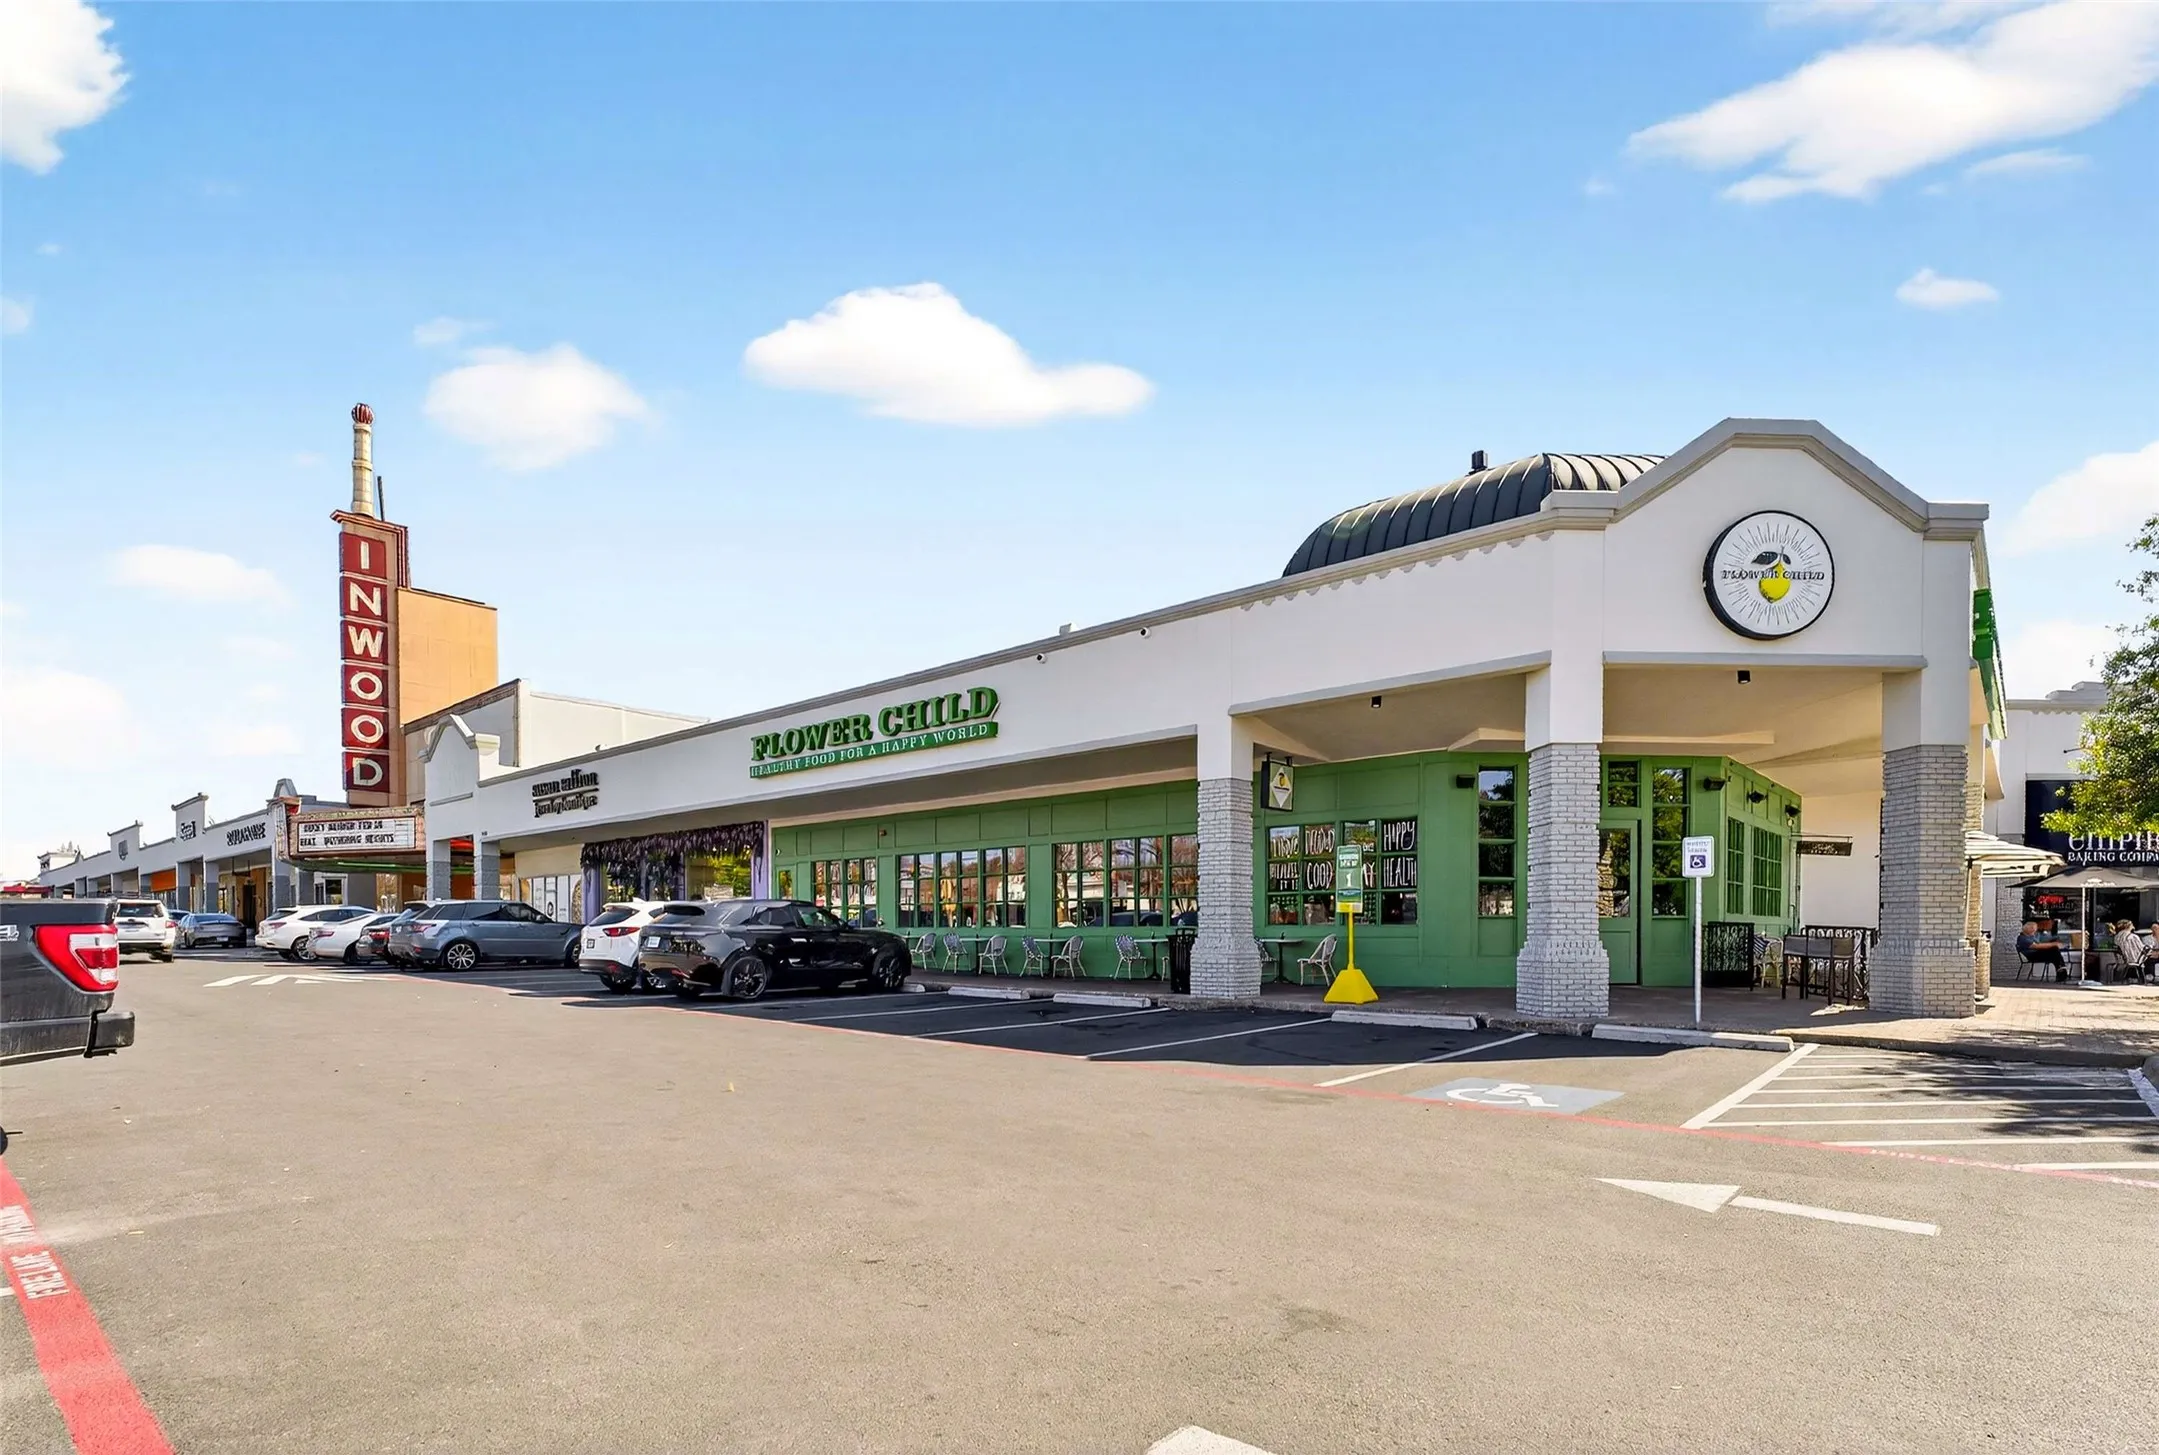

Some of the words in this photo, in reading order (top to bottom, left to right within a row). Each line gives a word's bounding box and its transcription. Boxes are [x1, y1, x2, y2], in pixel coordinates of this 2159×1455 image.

[347, 540, 385, 787] INWOOD
[751, 714, 873, 761] FLOWER
[878, 687, 998, 736] CHILD
[751, 759, 801, 777] HEALTHY
[804, 752, 835, 767] FOOD
[840, 748, 864, 761] FOR
[869, 744, 877, 755] A
[882, 735, 927, 753] HAPPY
[933, 725, 988, 744] WORLD
[1383, 857, 1417, 888] HEALTH
[2068, 851, 2116, 866] BAKING
